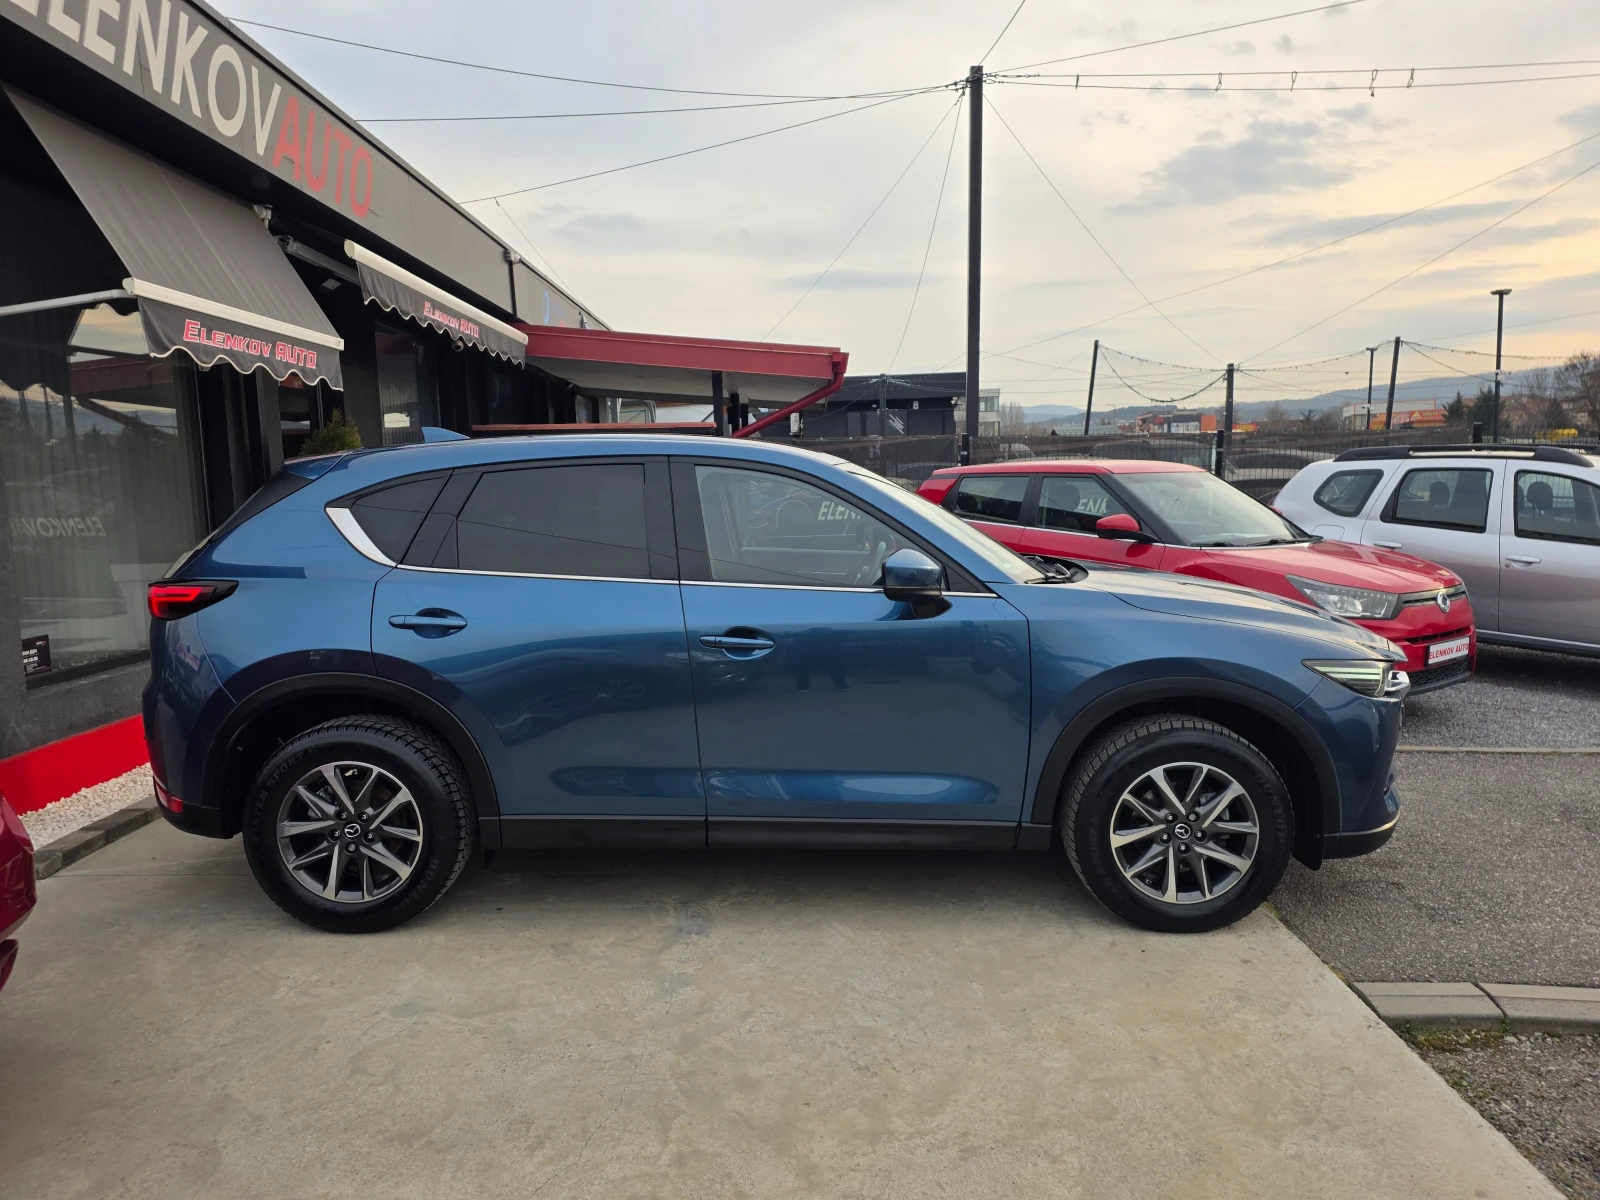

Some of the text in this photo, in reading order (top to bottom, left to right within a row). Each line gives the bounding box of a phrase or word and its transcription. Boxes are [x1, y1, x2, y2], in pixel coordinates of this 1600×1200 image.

[9, 0, 373, 218] LENKOV AUTO
[423, 301, 479, 338] ELENKOV AUTO
[183, 319, 317, 369] ELENKOV AUTO
[1429, 643, 1469, 659] ELENKOV AUTO
[266, 751, 304, 788] SPORT
